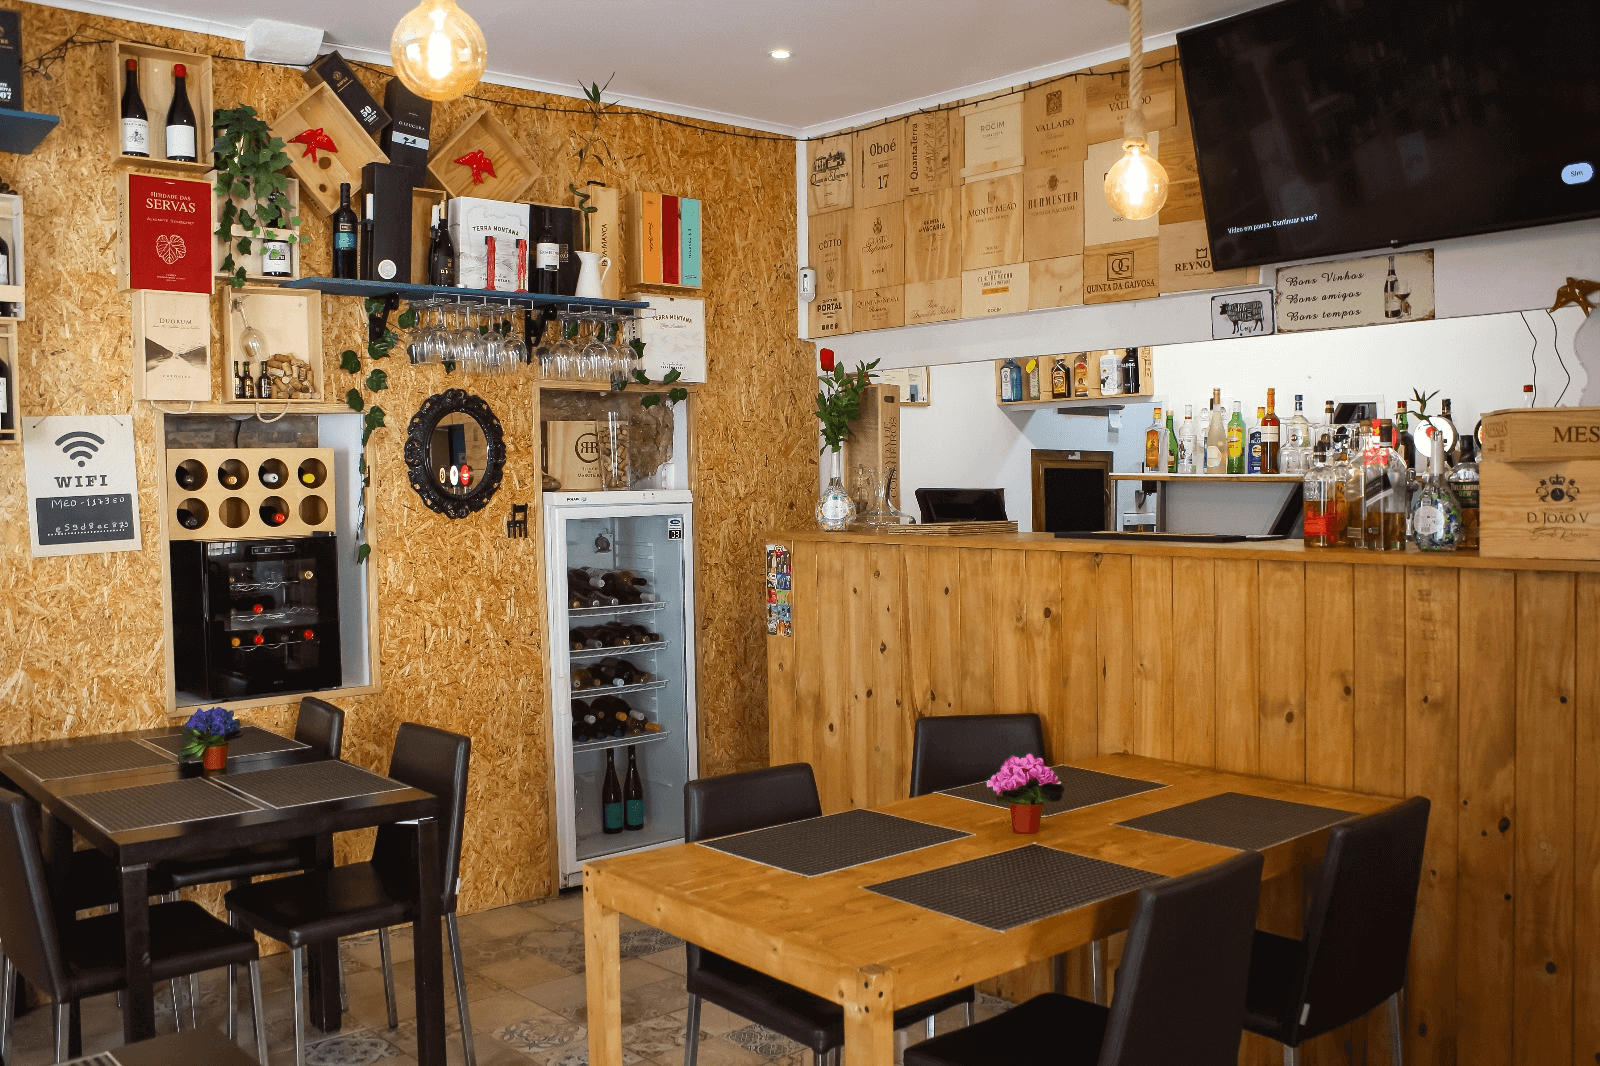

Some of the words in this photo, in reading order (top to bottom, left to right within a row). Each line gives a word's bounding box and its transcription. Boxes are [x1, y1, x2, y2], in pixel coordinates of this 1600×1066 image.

[360, 105, 372, 118] 50
[980, 120, 1005, 133] ROCIM
[1035, 118, 1075, 132] VALLADO
[869, 138, 897, 157] Oboé
[877, 174, 890, 190] 17
[150, 191, 178, 199] HERDADE
[1028, 191, 1078, 210] BURMESTER
[145, 197, 196, 214] SERVAS
[967, 206, 994, 218] MONTE
[1272, 217, 1299, 227] Continuar
[1304, 213, 1318, 221] ver?
[493, 225, 519, 236] MONTANA
[1174, 260, 1211, 272] REYNO
[1286, 276, 1318, 287] Bons
[1321, 271, 1365, 283] Vinhos
[1086, 282, 1112, 294] QUINTA
[1112, 281, 1123, 290] DA
[1124, 279, 1156, 292] GAIVOSA
[1286, 294, 1318, 304] Bons
[1321, 290, 1362, 302] amigos
[817, 301, 843, 313] PORTAL
[159, 317, 192, 325] DUORUM
[1286, 311, 1319, 322] Bons
[1322, 309, 1362, 320] tempos
[54, 474, 108, 488] WIFI
[1527, 511, 1539, 523] D.
[1543, 511, 1576, 525] JOÃO
[1578, 512, 1590, 524] V
